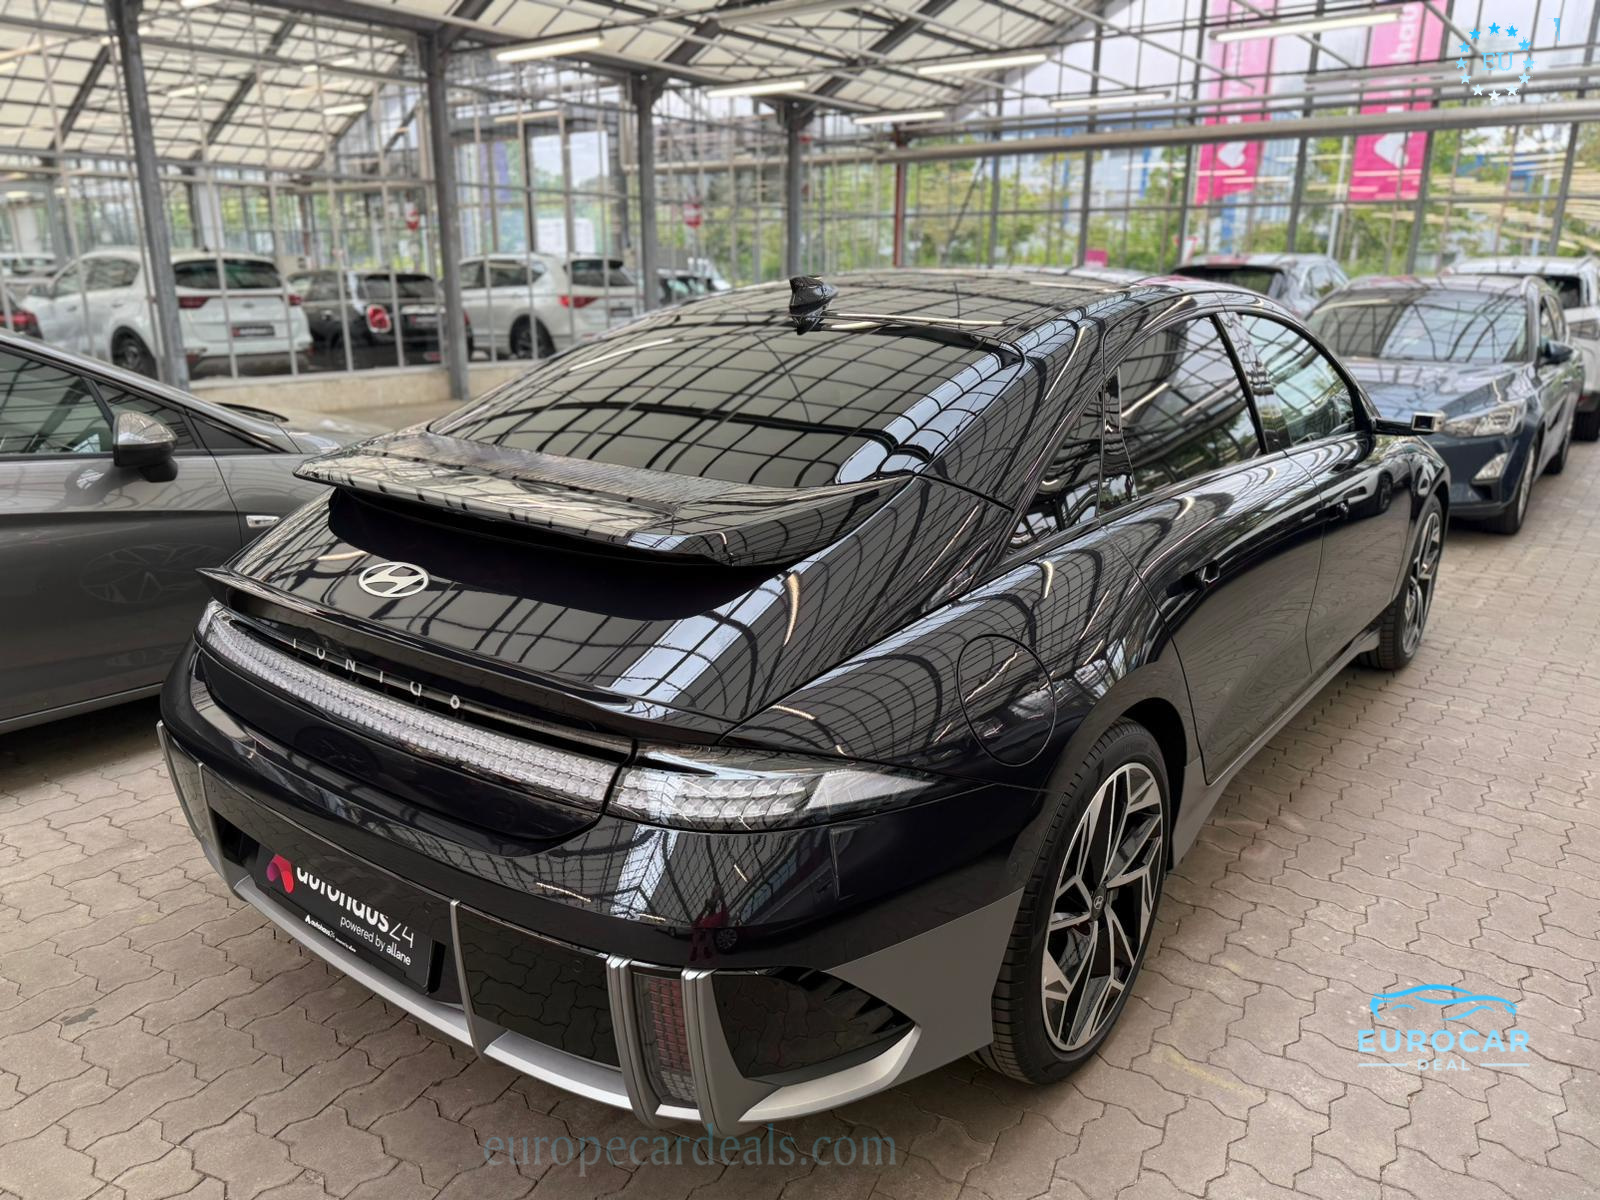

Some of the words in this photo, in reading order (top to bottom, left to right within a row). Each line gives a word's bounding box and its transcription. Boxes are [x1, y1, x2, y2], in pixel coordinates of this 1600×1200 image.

[340, 916, 375, 943] powered
[375, 935, 386, 952] by
[386, 942, 412, 966] allane
